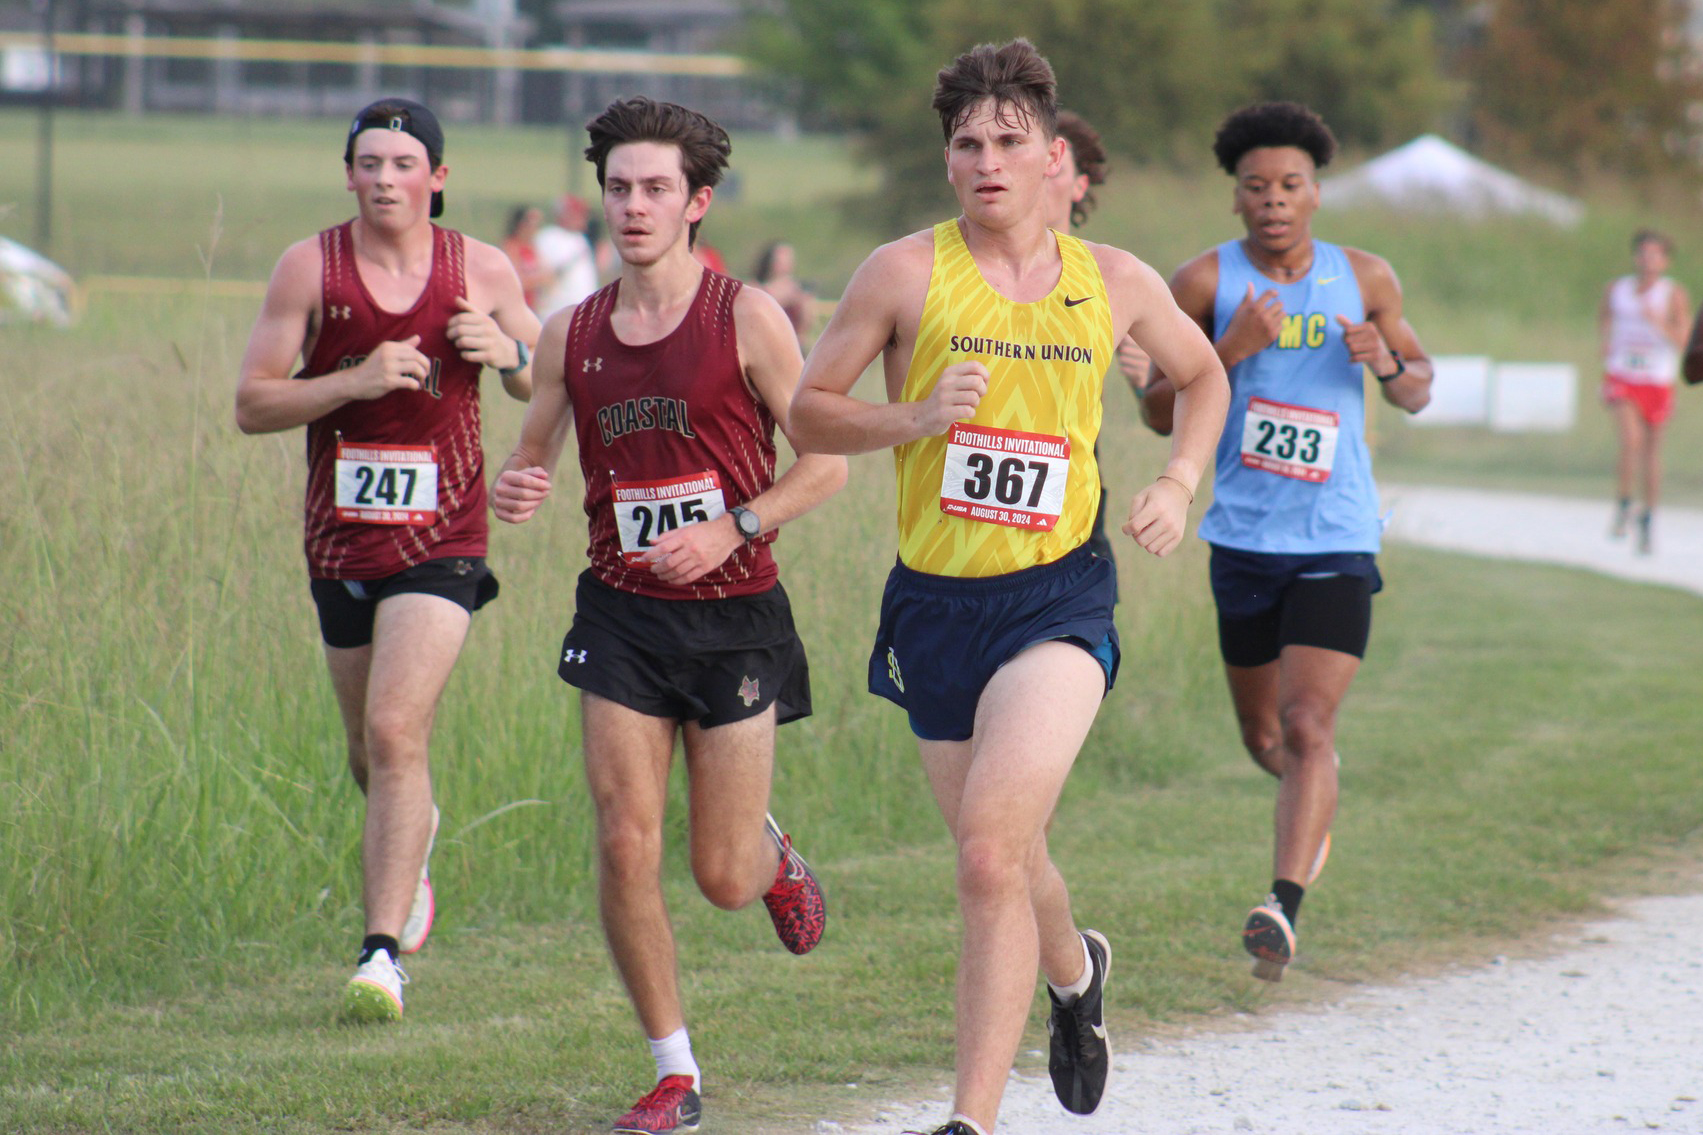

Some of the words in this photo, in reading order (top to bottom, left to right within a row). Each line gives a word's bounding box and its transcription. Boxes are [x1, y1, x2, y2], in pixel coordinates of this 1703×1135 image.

[1276, 312, 1326, 349] MC
[950, 335, 1036, 360] SOUTHERN
[1041, 344, 1093, 364] UNION
[596, 396, 696, 447] COASTAL
[953, 430, 1003, 450] FOOTHILLS
[1004, 437, 1065, 458] INVITATIONAL
[1255, 419, 1321, 464] 233
[355, 466, 417, 506] 247
[616, 487, 656, 501] FOOTHILLS
[656, 477, 717, 499] INVITATIONAL
[963, 452, 1049, 508] 367
[970, 506, 998, 521] AUGUST
[998, 512, 1011, 524] 30,
[1012, 514, 1031, 525] 2024
